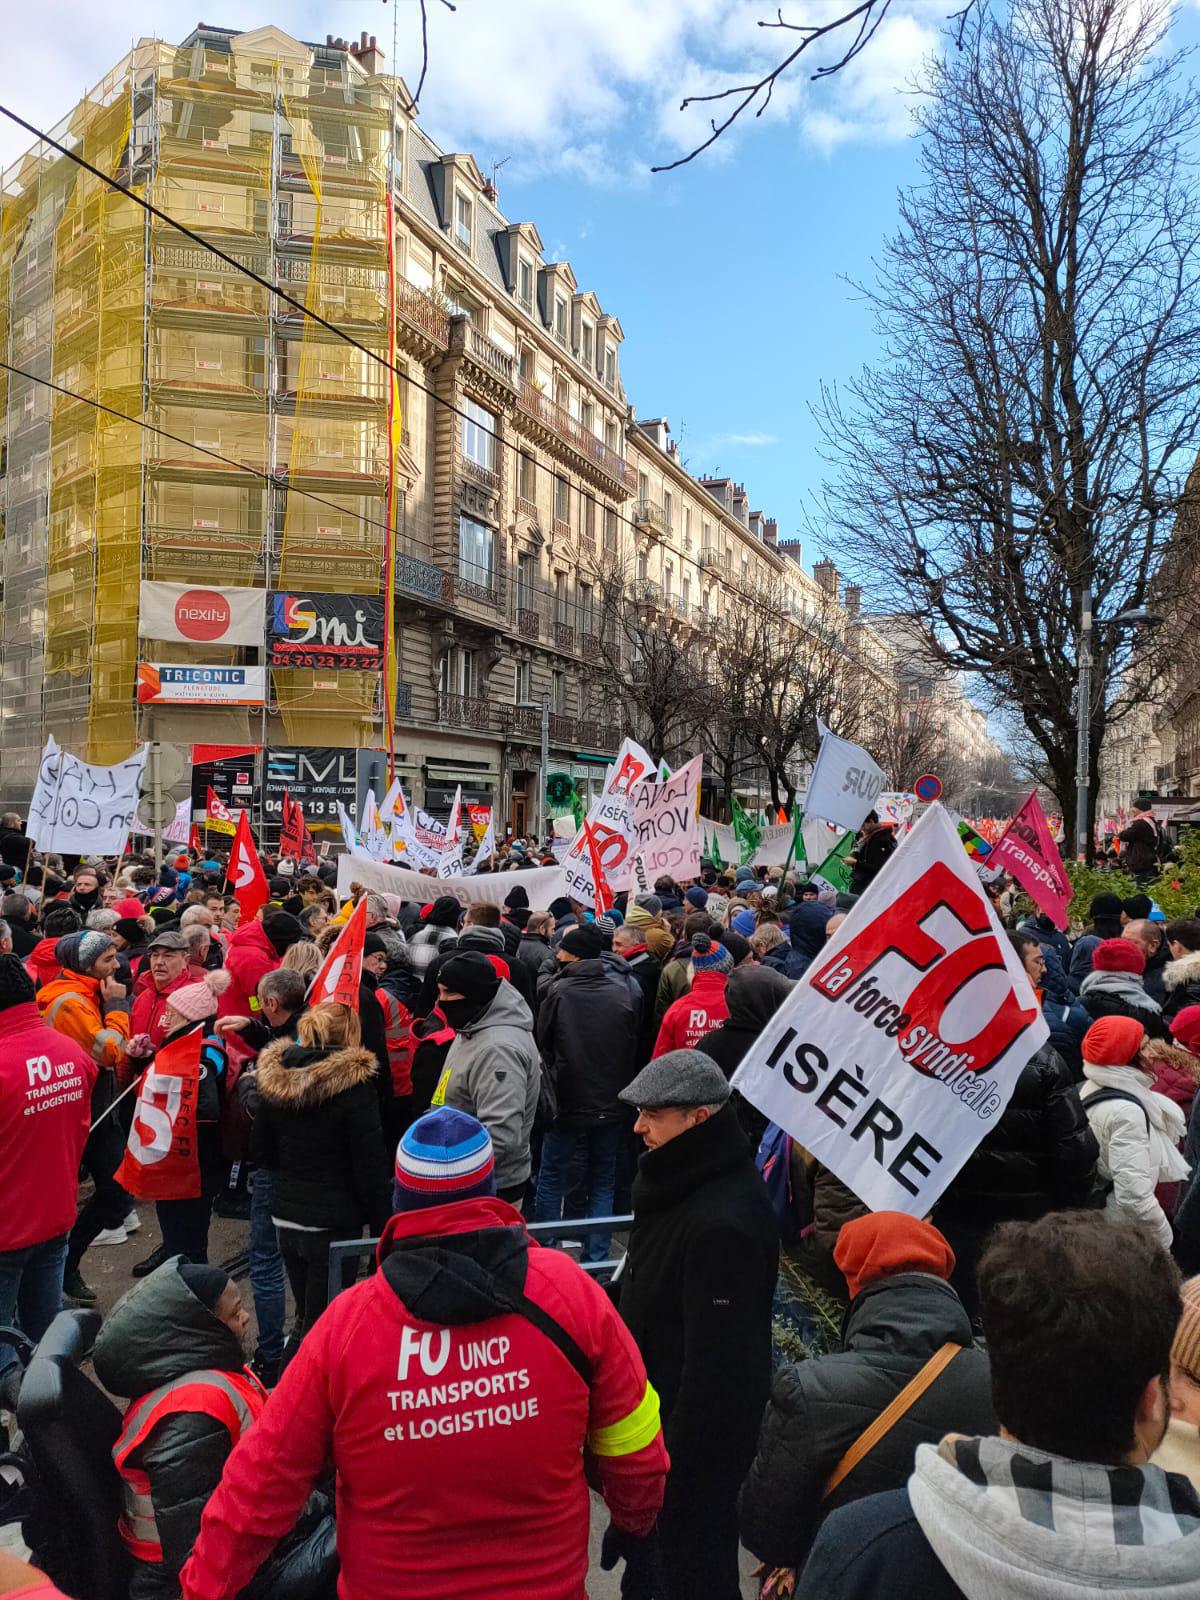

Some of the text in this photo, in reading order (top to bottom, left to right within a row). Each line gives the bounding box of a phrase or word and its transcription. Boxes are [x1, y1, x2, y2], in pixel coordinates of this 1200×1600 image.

[178, 608, 226, 622] nexity
[165, 669, 240, 683] TRICONIC
[272, 655, 379, 669] 04 76 23 22 22
[308, 801, 325, 814] 13
[808, 859, 1038, 1081] FO
[688, 1009, 724, 1028] FO UNC
[820, 953, 1001, 1119] la force syndicale
[25, 1055, 76, 1087] FO UNCP
[23, 1089, 83, 1116] et LOGISTIQUE
[25, 1076, 83, 1101] TRANSPORTS
[765, 1026, 943, 1198] ISÈRE
[458, 1336, 511, 1371] UNCP
[387, 1368, 531, 1411] TRANSPORTS
[384, 1397, 540, 1441] et LOGISTIQUE
